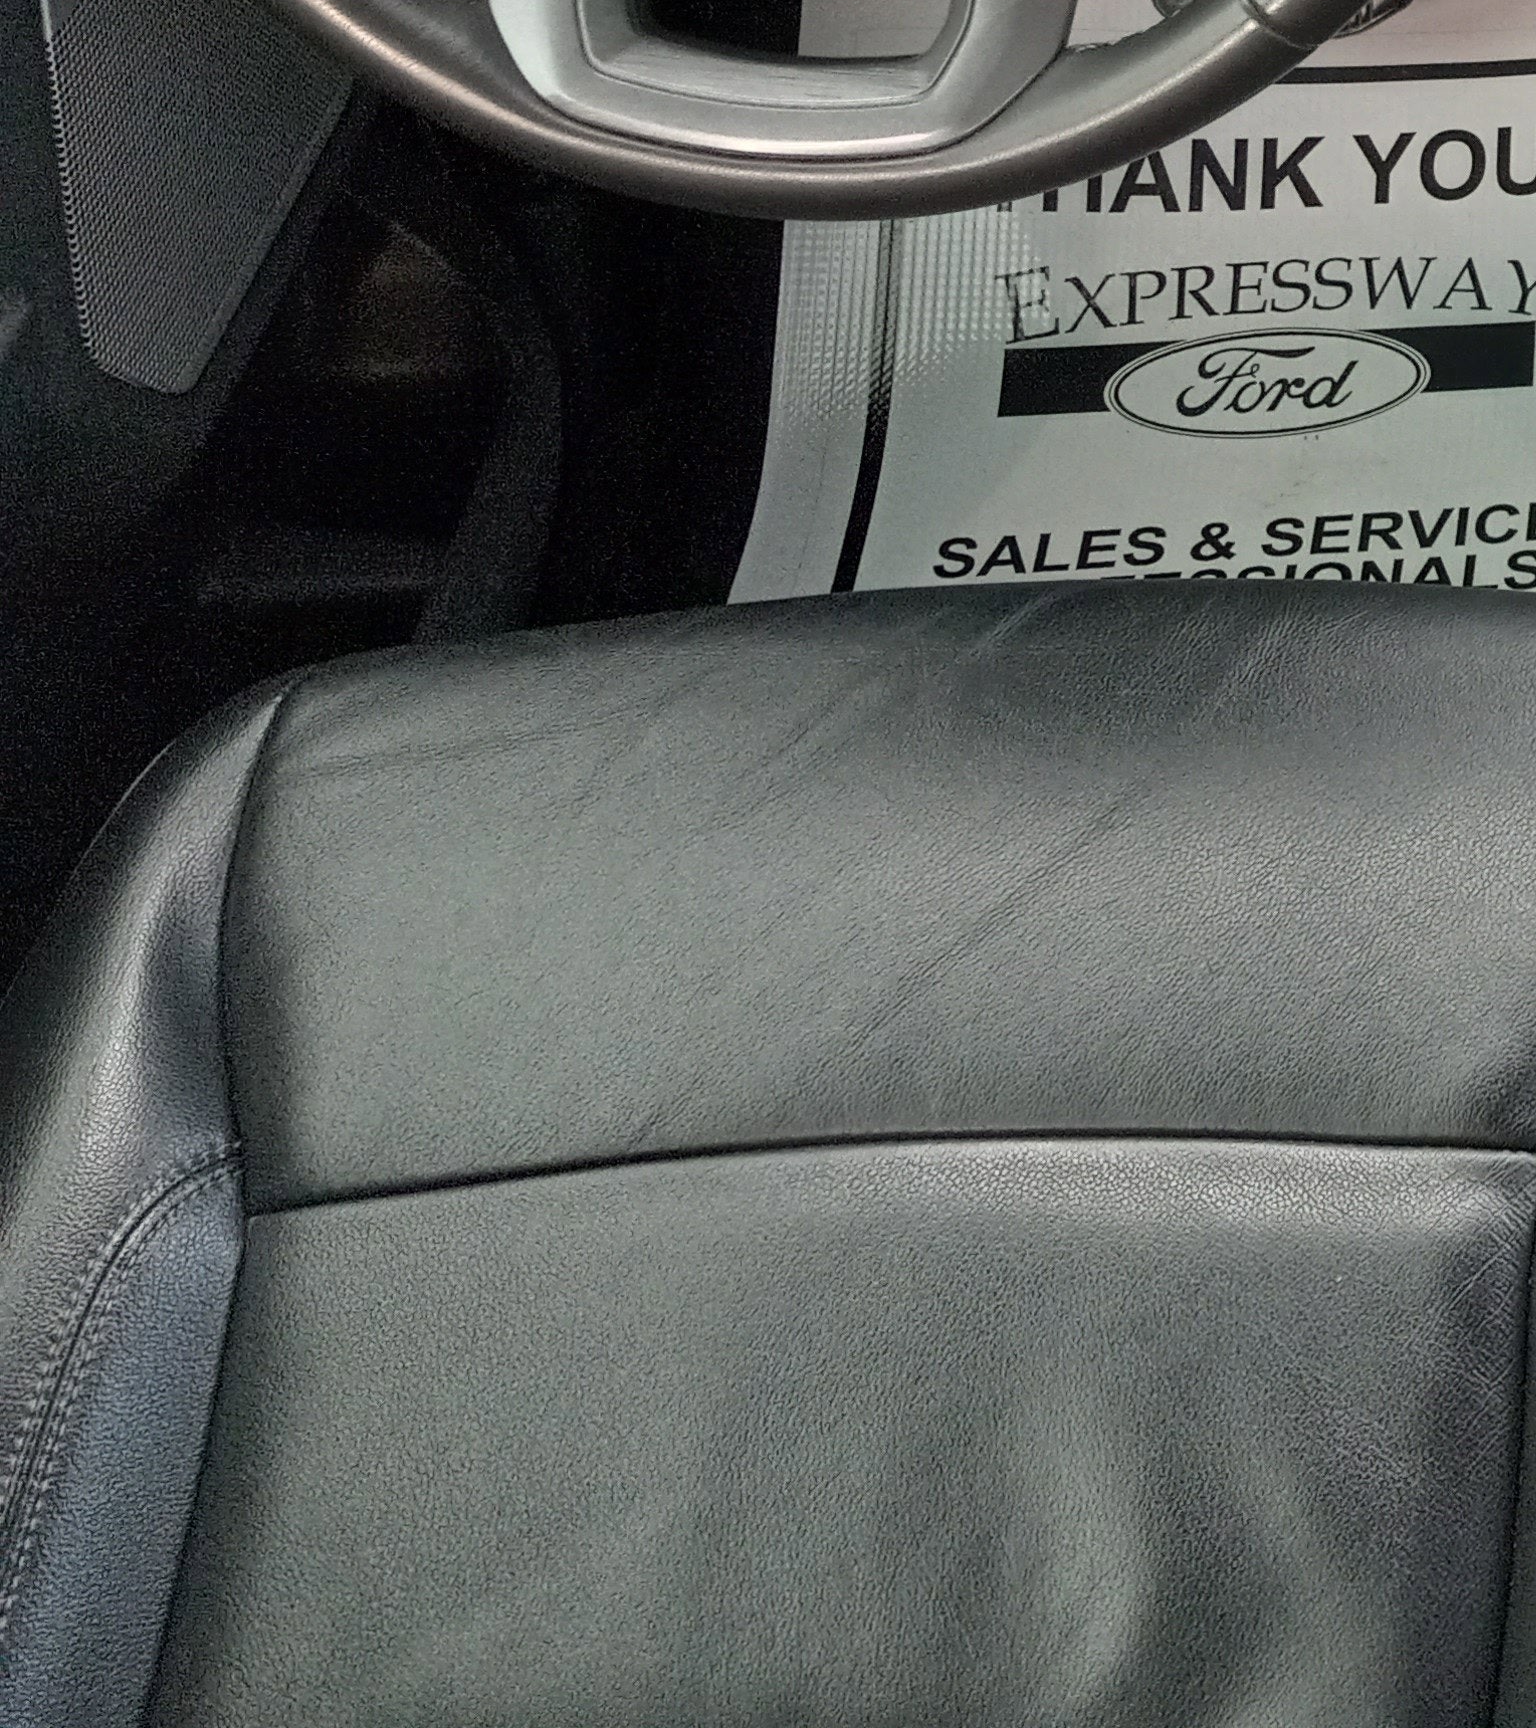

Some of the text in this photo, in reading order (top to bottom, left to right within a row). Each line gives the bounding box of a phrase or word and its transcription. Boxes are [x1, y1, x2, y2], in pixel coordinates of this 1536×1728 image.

[999, 135, 1326, 213] ANK
[1174, 346, 1361, 418] Ford
[932, 525, 1167, 580] SALES
[1189, 521, 1236, 562] &
